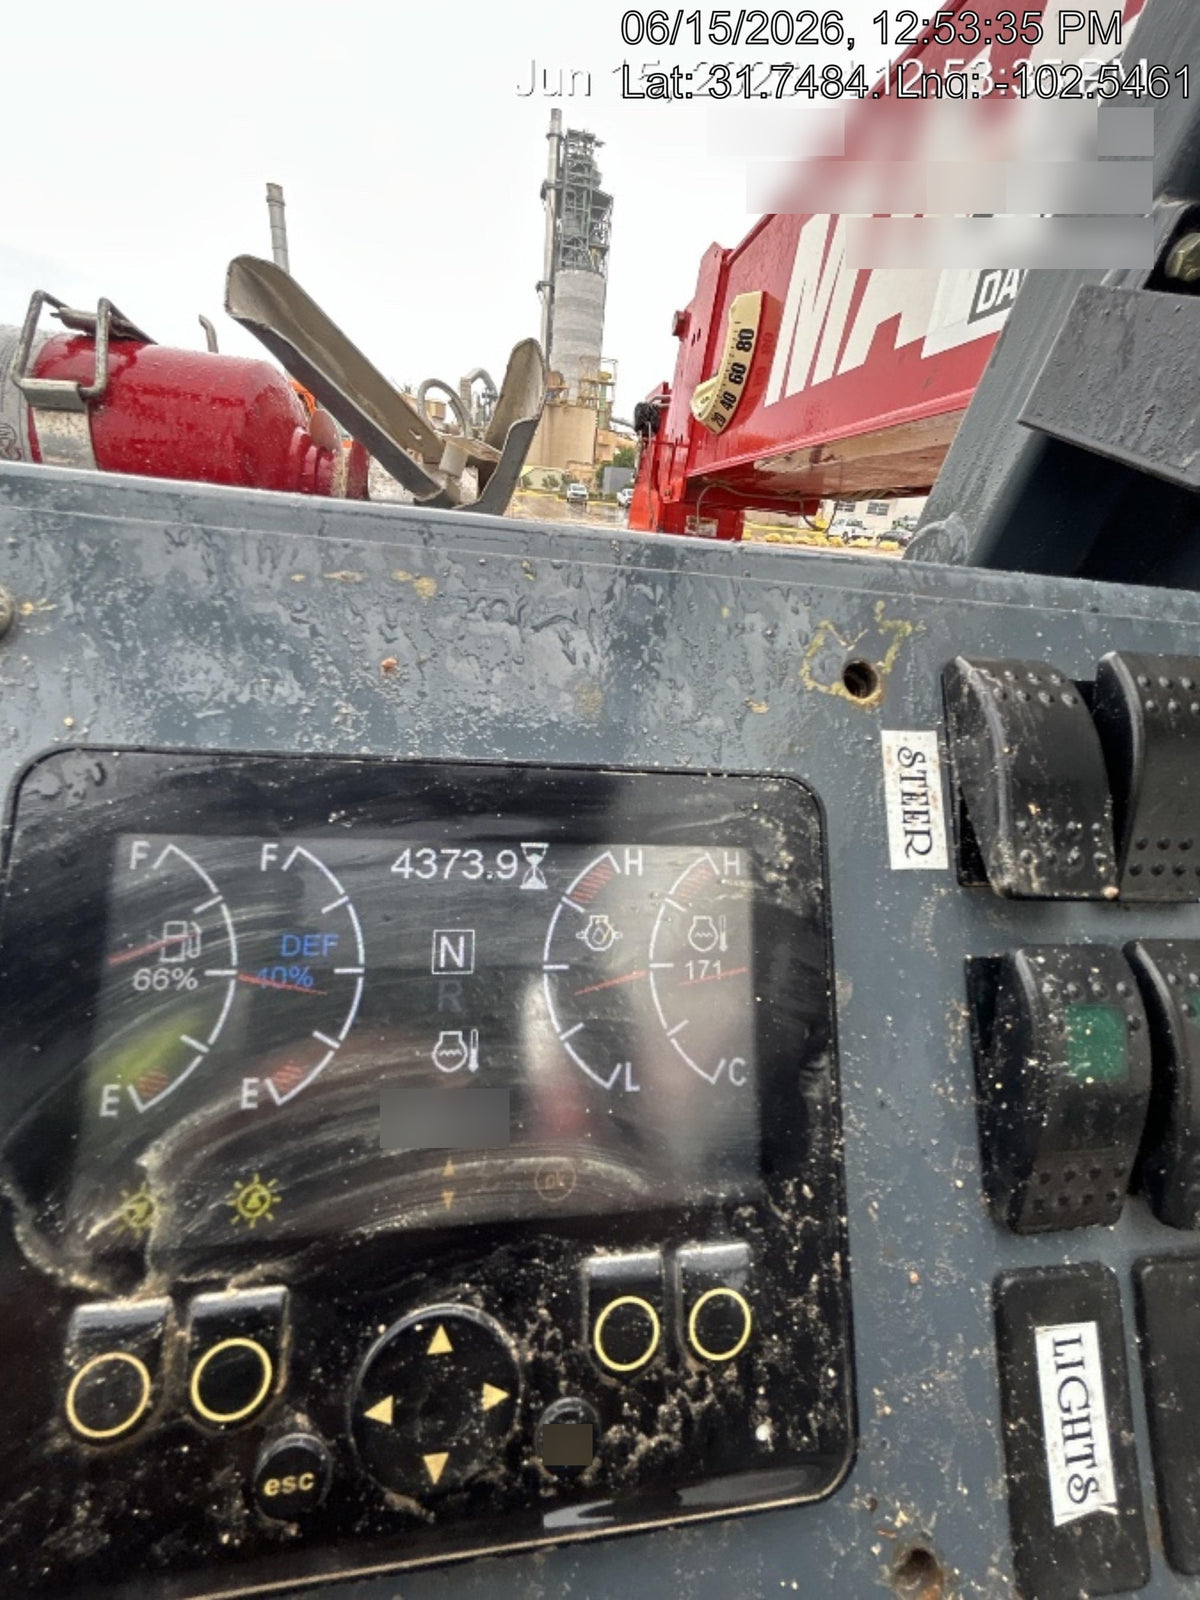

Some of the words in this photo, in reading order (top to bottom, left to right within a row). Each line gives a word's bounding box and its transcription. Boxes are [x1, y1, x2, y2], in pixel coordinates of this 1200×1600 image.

[735, 328, 755, 353] 80
[728, 362, 747, 385] 60
[720, 390, 738, 411] 40
[896, 747, 934, 860] STEER
[130, 841, 150, 870] F
[260, 844, 279, 871] F
[390, 848, 518, 880] 4373.9
[624, 848, 643, 876] H
[723, 850, 741, 876] H
[281, 934, 340, 957] DEF
[439, 936, 466, 969] N
[132, 967, 199, 991] 66%
[684, 960, 722, 981] 171
[625, 1062, 641, 1092] L
[728, 1058, 747, 1087] C
[100, 1084, 120, 1117] E
[240, 1077, 260, 1110] E
[1051, 1332, 1100, 1505] LIGHTS
[264, 1472, 315, 1497] esc
